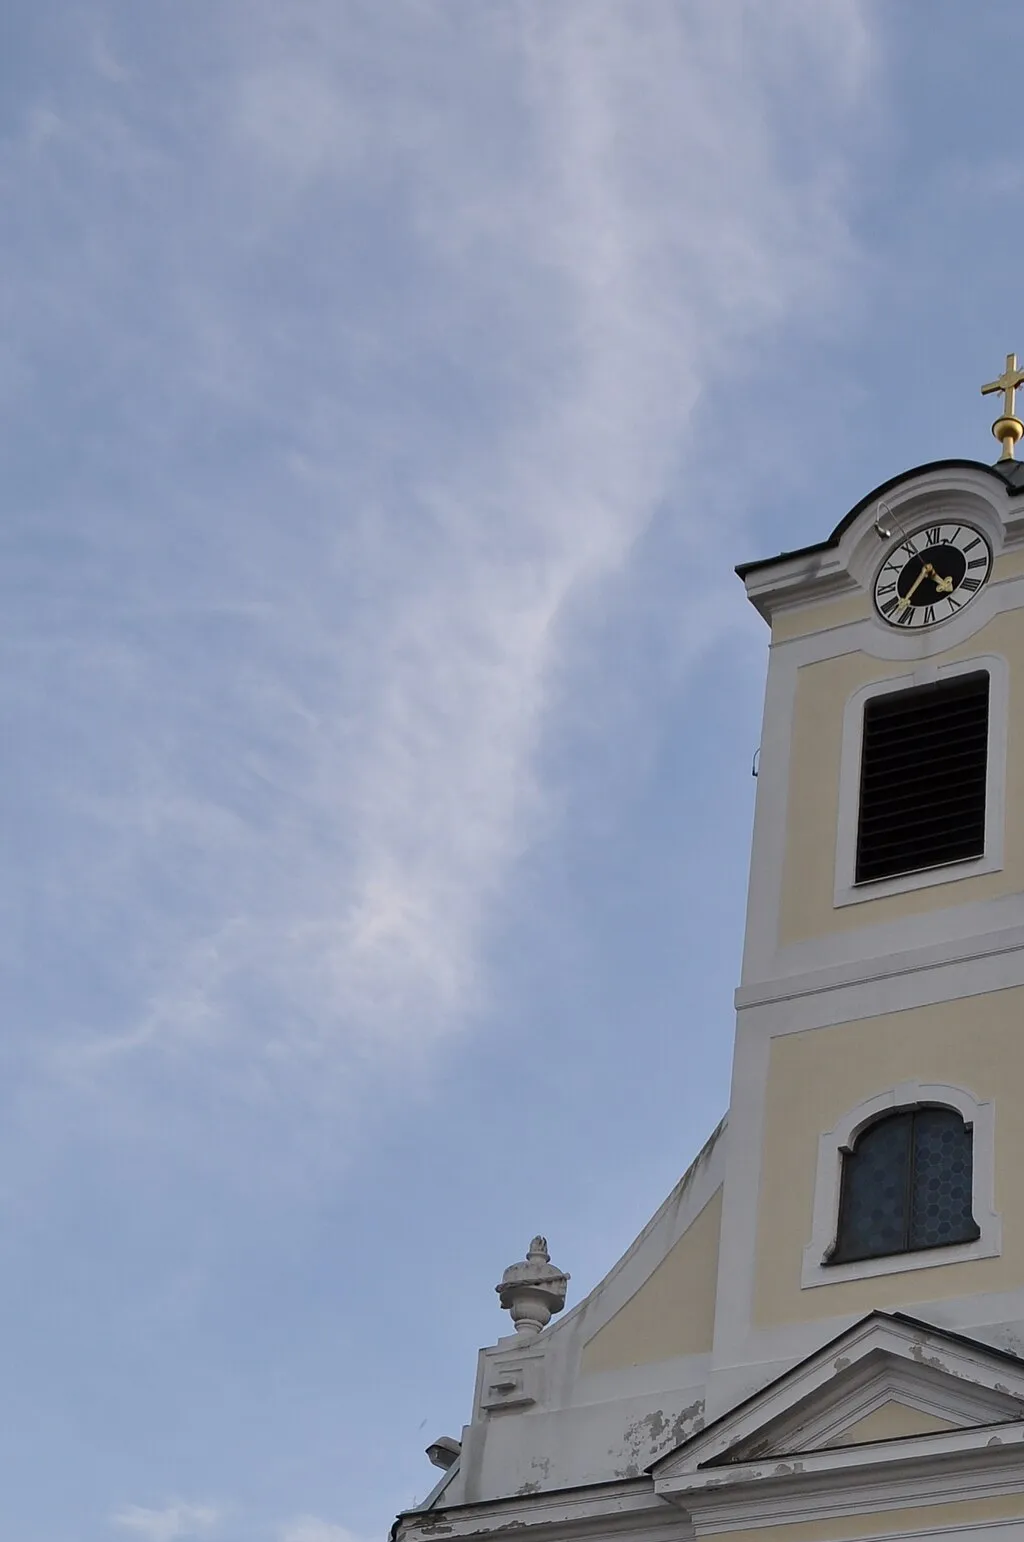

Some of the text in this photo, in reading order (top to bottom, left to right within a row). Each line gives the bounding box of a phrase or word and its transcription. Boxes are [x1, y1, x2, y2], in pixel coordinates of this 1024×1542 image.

[925, 527, 940, 547] XII
[963, 537, 982, 554] II
[883, 562, 903, 574] X
[968, 556, 987, 569] III
[877, 581, 896, 596] IX
[959, 577, 983, 592] IIII
[947, 596, 961, 612] V
[923, 605, 936, 624] VI
